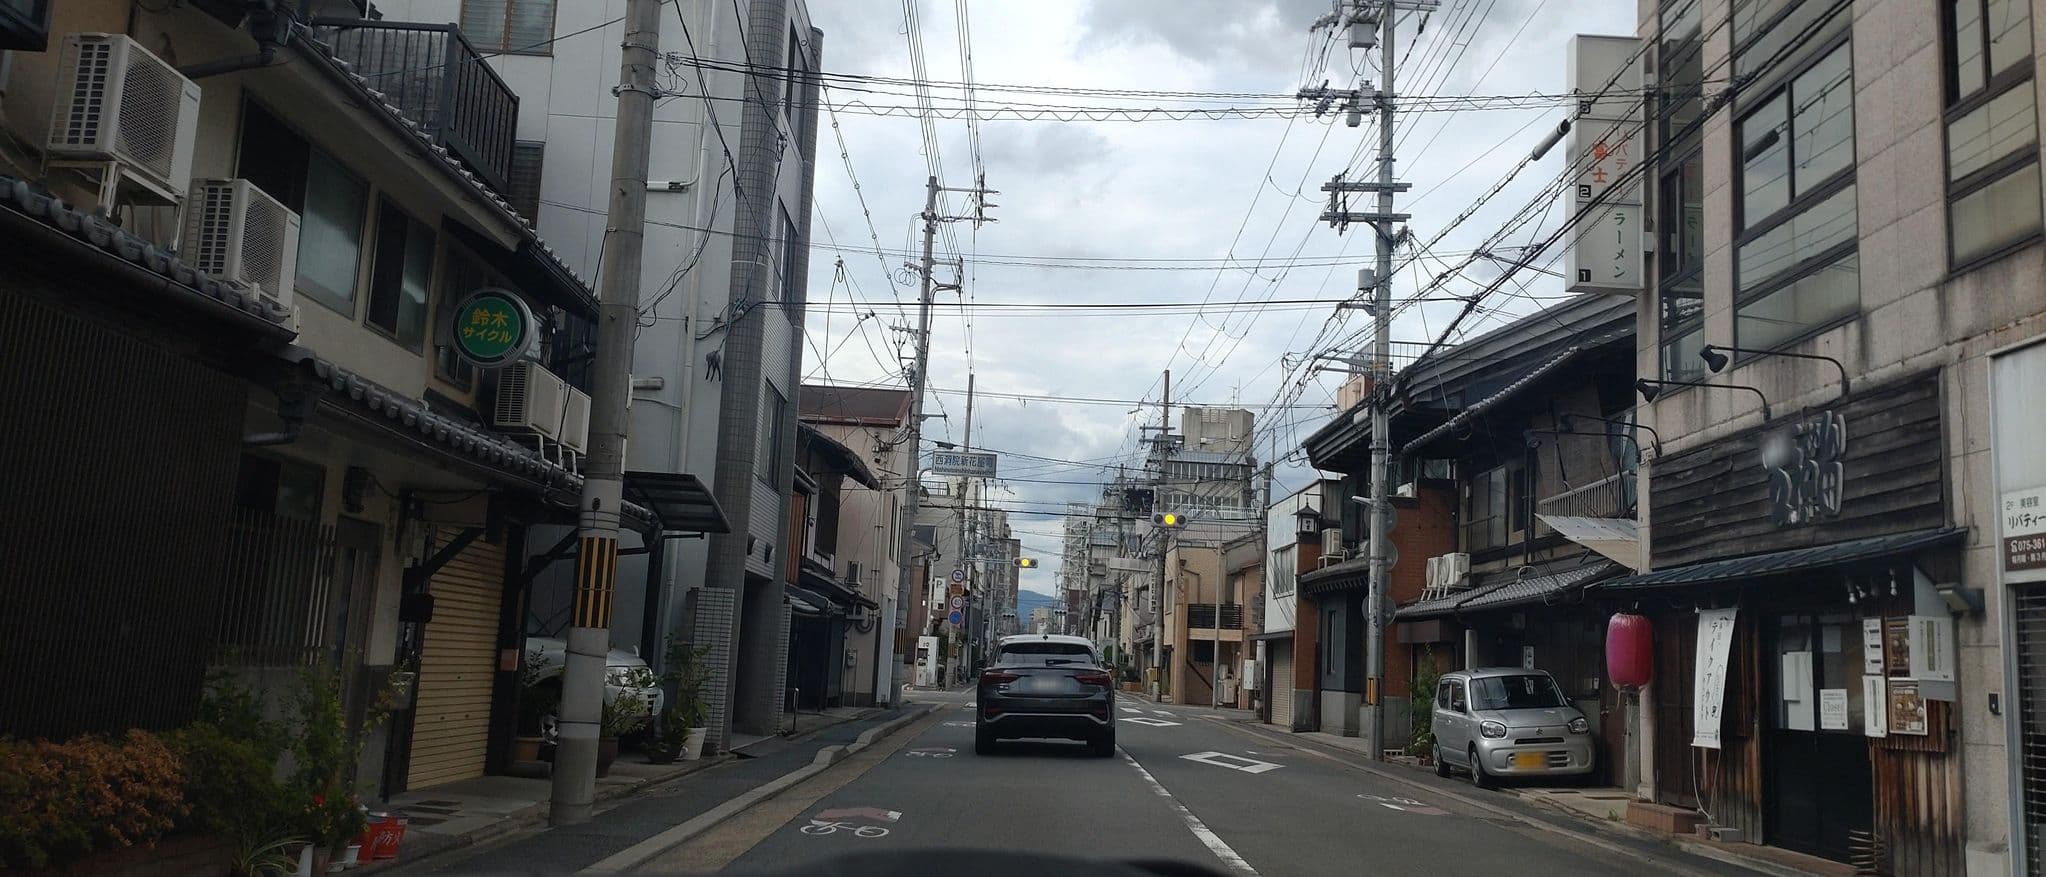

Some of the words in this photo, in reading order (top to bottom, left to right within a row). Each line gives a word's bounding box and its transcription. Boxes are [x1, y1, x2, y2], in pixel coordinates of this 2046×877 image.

[1580, 186, 1591, 197] 2
[1614, 213, 1625, 279] ラーメン
[1580, 270, 1590, 281] 1
[471, 308, 509, 327] 鈴木
[463, 326, 513, 343] サイクル
[936, 579, 942, 588] P
[1704, 621, 1719, 721] テイクアウト
